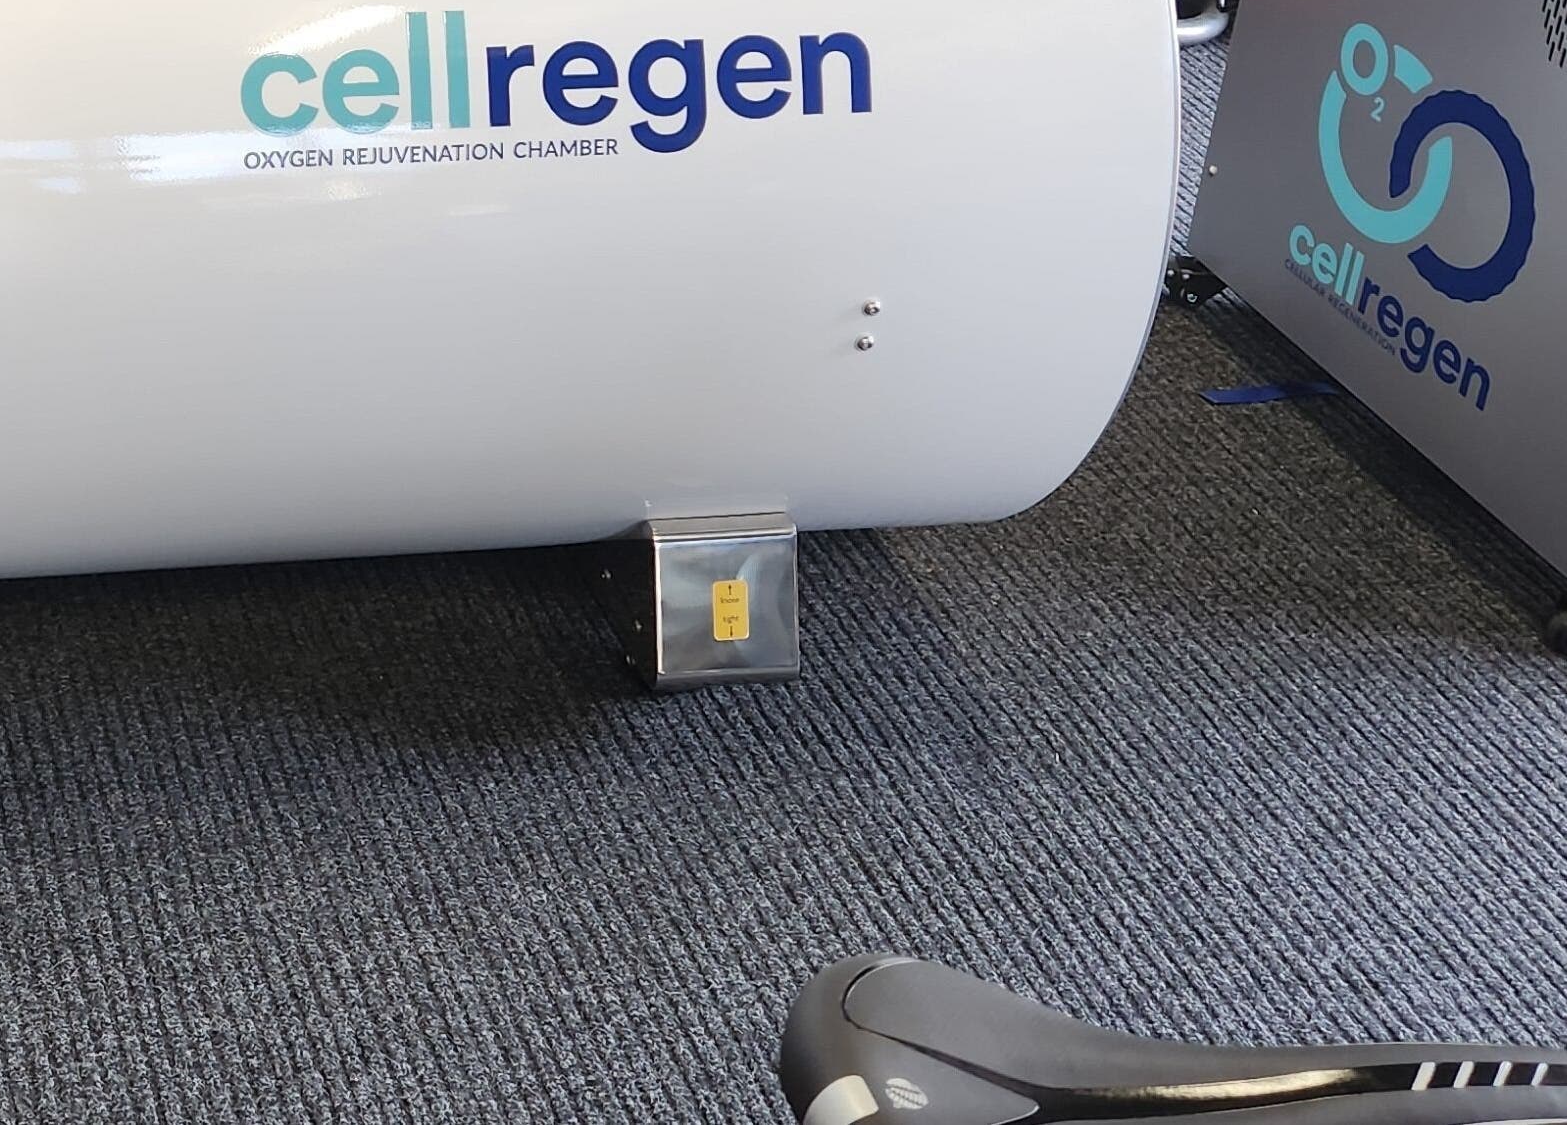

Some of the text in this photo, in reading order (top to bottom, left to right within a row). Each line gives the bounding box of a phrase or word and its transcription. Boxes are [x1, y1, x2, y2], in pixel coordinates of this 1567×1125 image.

[239, 10, 873, 153] cellregen
[243, 138, 619, 170] OXYGEN REJUVENATION CHAMBER
[1288, 224, 1492, 411] cellregen
